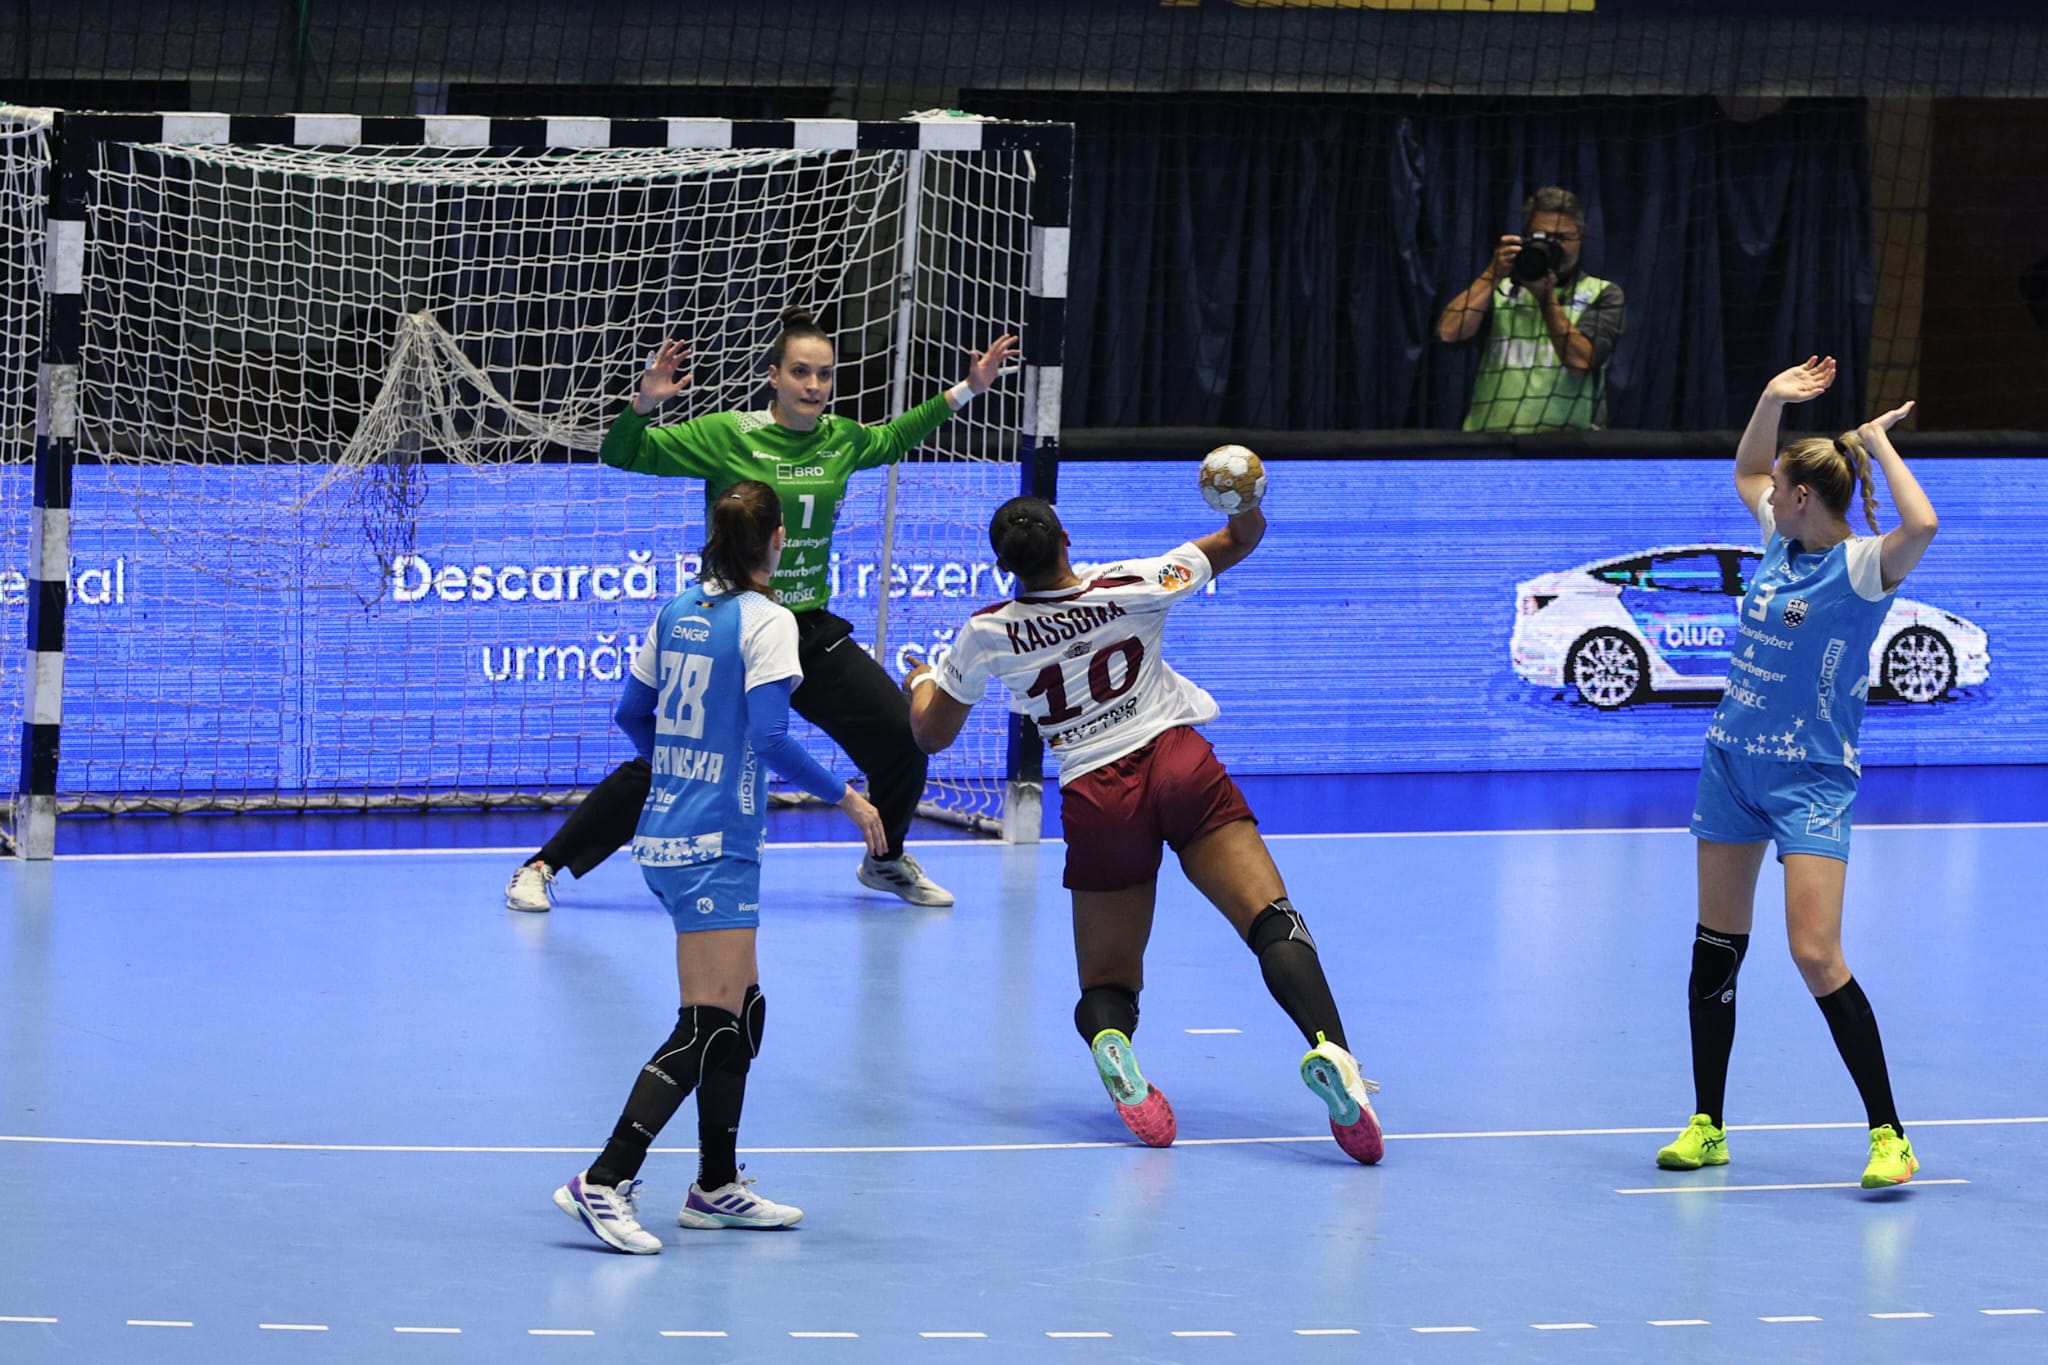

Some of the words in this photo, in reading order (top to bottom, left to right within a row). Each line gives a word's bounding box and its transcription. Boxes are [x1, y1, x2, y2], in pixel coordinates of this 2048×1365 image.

[794, 466, 825, 478] BRD
[391, 549, 657, 602] Descarcă
[857, 562, 1016, 599] rezerv
[1748, 583, 1777, 622] 3
[1787, 599, 1809, 612] CSM
[1665, 622, 1726, 649] blue
[1738, 621, 1794, 650] Stanleybet
[655, 650, 714, 739] 28
[1027, 635, 1145, 726] 10
[738, 902, 760, 912] Kemp
